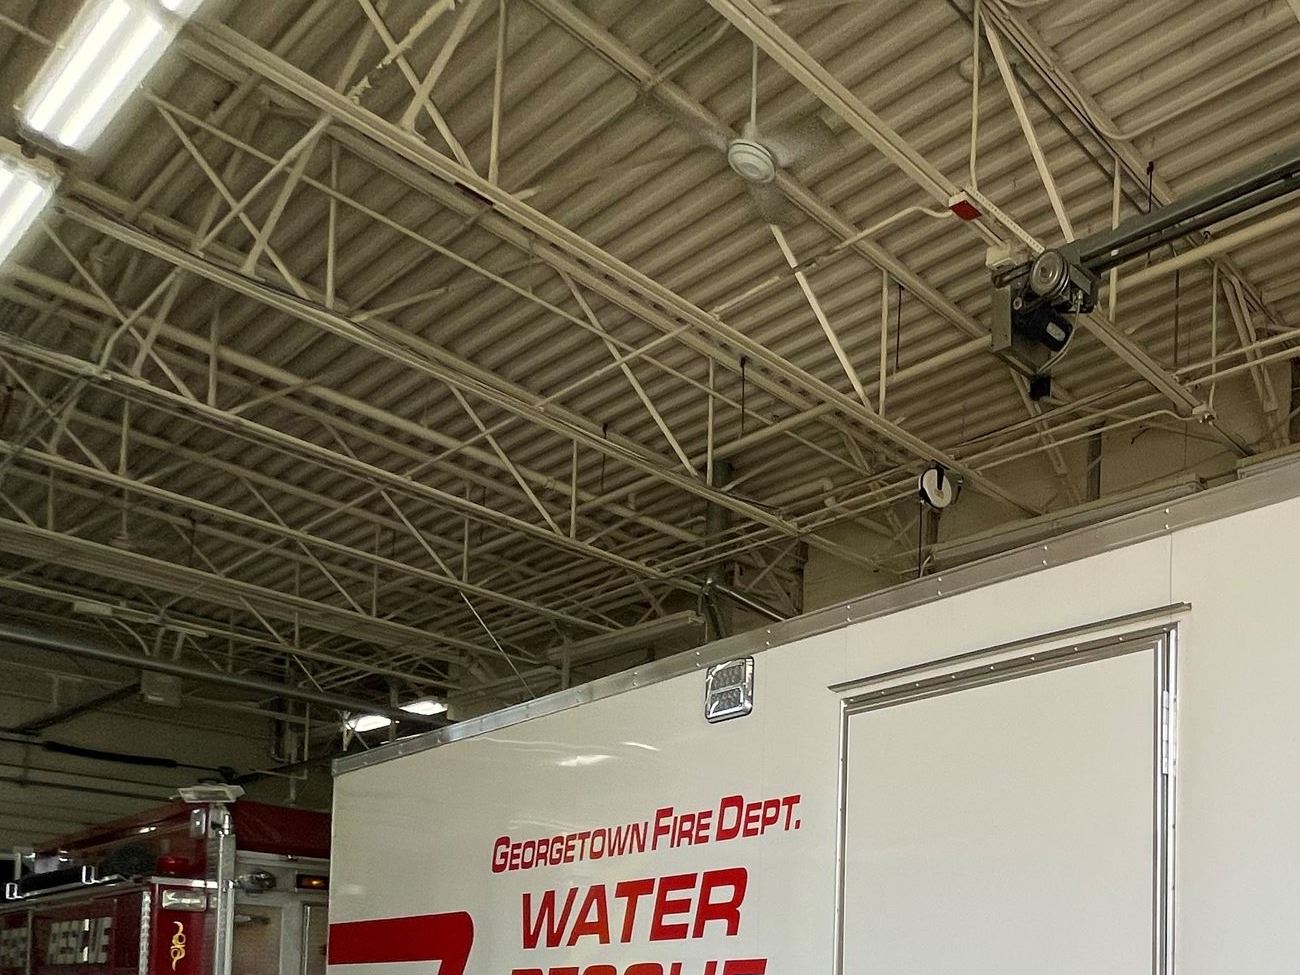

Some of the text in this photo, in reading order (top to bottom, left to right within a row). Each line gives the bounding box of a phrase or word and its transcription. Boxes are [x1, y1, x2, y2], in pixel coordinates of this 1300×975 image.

[491, 795, 801, 874] GEORGETOWN FIRE DEPT.
[522, 867, 748, 949] WATER
